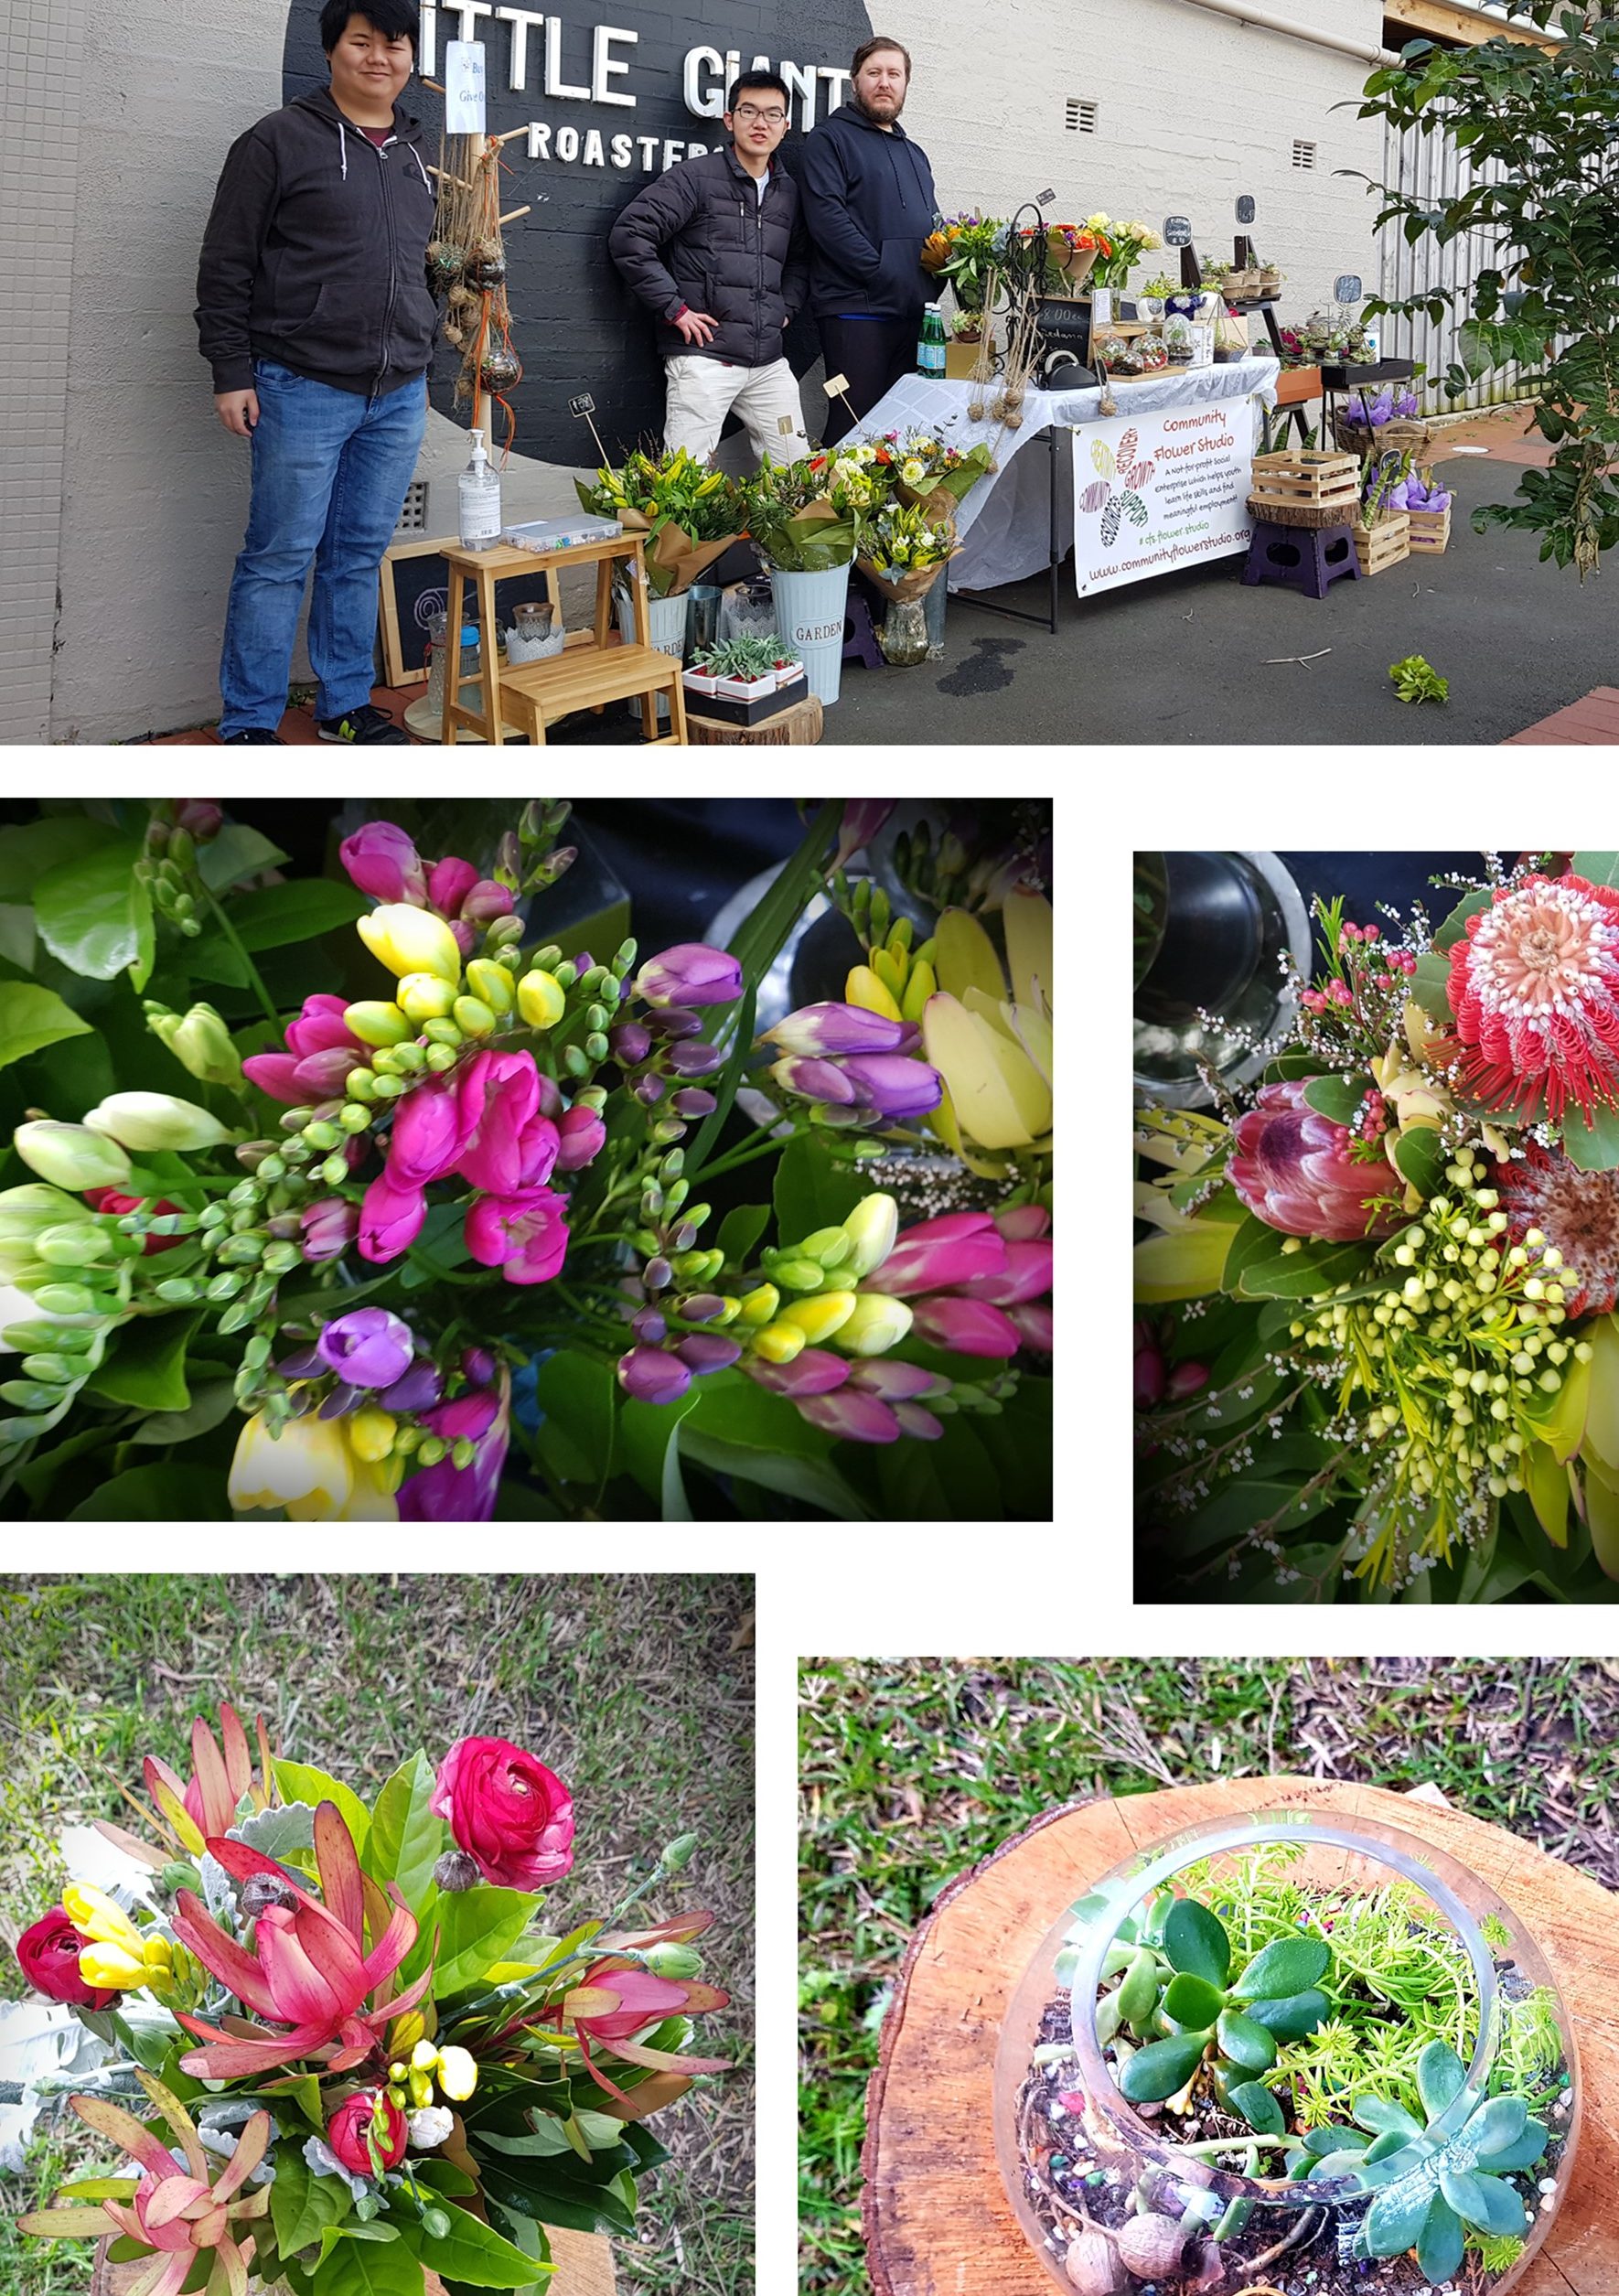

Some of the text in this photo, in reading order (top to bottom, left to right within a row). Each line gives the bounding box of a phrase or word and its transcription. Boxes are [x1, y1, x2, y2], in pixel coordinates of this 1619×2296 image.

[418, 0, 852, 134] ITTLE GINT
[528, 122, 724, 173] ROASTE
[1163, 409, 1227, 432] Community
[1116, 427, 1138, 474] RECOVERY
[1154, 433, 1234, 461] Flower Studio
[1125, 460, 1156, 490] GROWTH
[1207, 471, 1224, 482] helps
[1224, 467, 1241, 479] youth
[1164, 495, 1182, 505] learn
[1208, 485, 1221, 494] and
[1222, 481, 1234, 493] find
[1100, 495, 1122, 548] RESOURCES
[1120, 489, 1149, 528] SUPPORT
[1163, 504, 1197, 520] meaningful
[1088, 529, 1250, 581] www.communityflowerstudio.org
[796, 620, 842, 640] GARDEN
